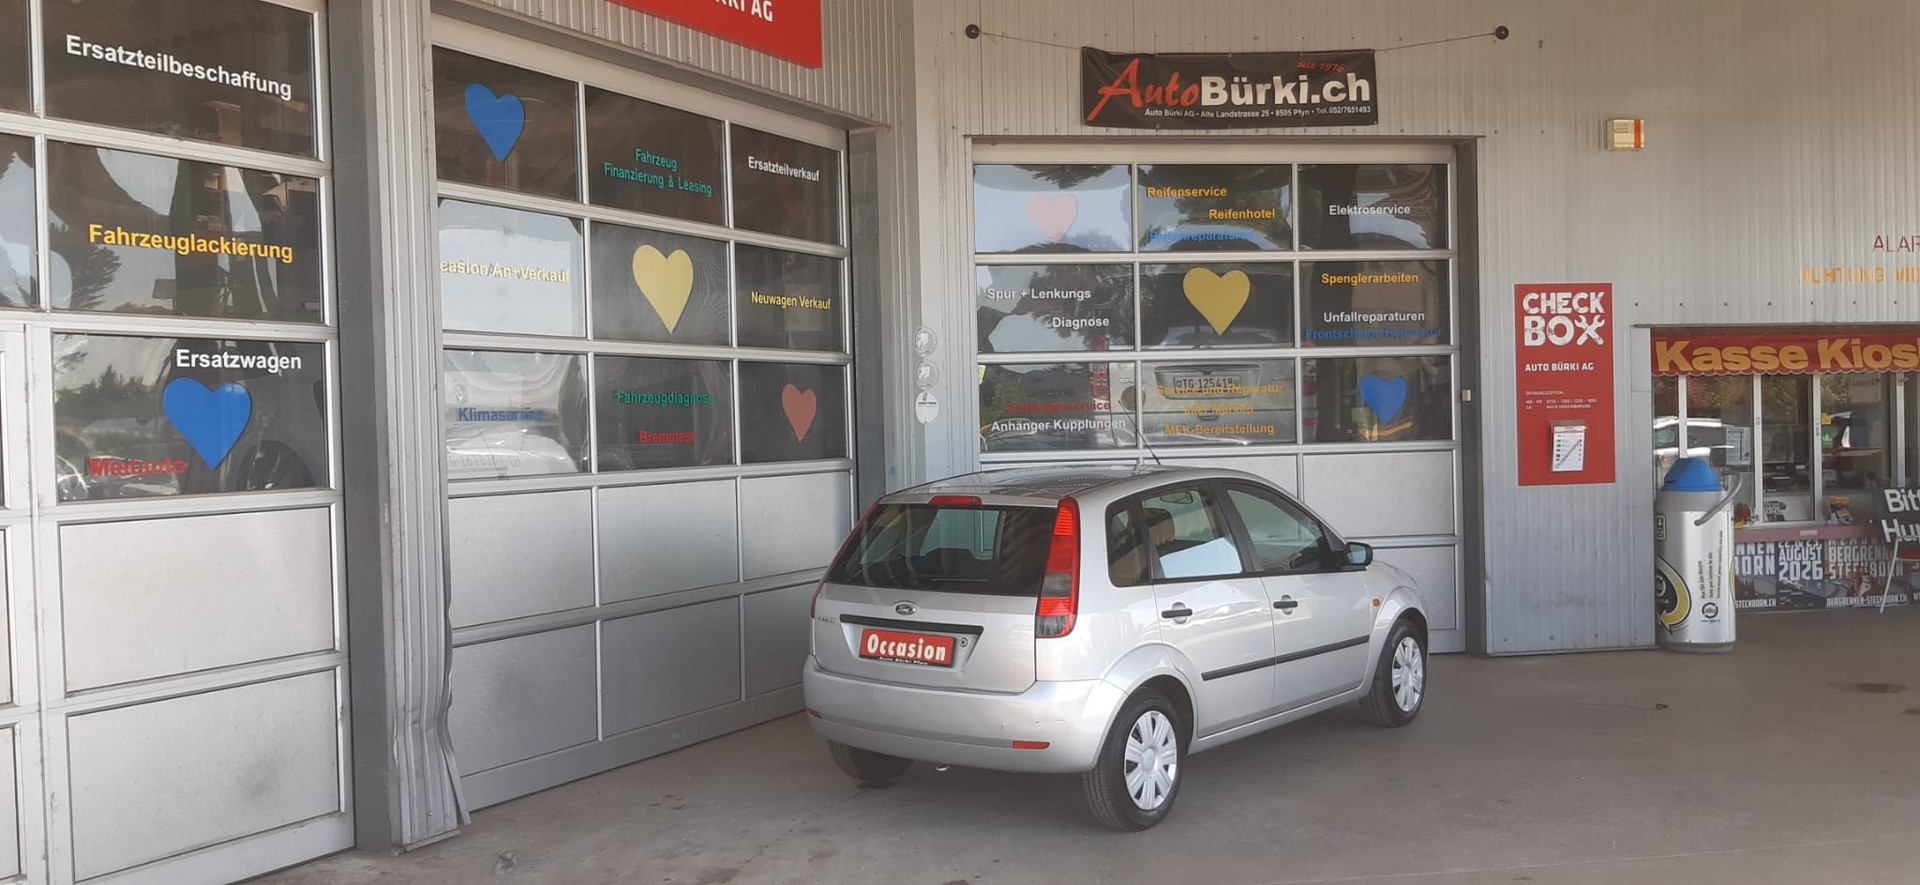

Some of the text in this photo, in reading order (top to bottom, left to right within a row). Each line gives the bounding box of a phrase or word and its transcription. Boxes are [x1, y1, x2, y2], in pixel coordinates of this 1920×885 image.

[751, 0, 774, 22] AG
[66, 34, 292, 101] Ersatzteilbeschaffung
[1144, 108, 1163, 116] Auto
[1216, 110, 1259, 118] Landstrasse
[1261, 109, 1270, 117] 25
[1275, 109, 1292, 117] 8505
[635, 148, 677, 172] Fahrzeug
[748, 156, 821, 183] Ersatzteilverkauf
[603, 162, 712, 197] Finanzierung & Leasing
[1147, 186, 1228, 198] Reifenservice
[1208, 208, 1276, 220] Reifenhotel
[1329, 204, 1411, 215] Elektroservice
[89, 224, 293, 264] Fahrzeuglackierung
[1321, 272, 1419, 286] Spenglerarbeiten
[1799, 266, 1885, 284] ACHTUNG
[751, 291, 832, 310] Neuwagen Verkauf
[987, 288, 1092, 302] Spur + Lenkungs
[1522, 291, 1605, 315] CHECK
[1052, 317, 1110, 330] Diagnose
[1323, 311, 1425, 323] Unfallreparaturen
[1523, 315, 1605, 346] BOX
[176, 349, 302, 373] Ersatzwagen
[1655, 340, 1809, 372] Kasse
[1524, 361, 1594, 372] AUTO BÜRKI AG
[991, 418, 1126, 434] Anhänger Kupplungen
[89, 457, 186, 477] Mietauto
[1779, 546, 1822, 561] AUGUST
[1779, 560, 1823, 581] 2026
[867, 633, 946, 661] Occasion
